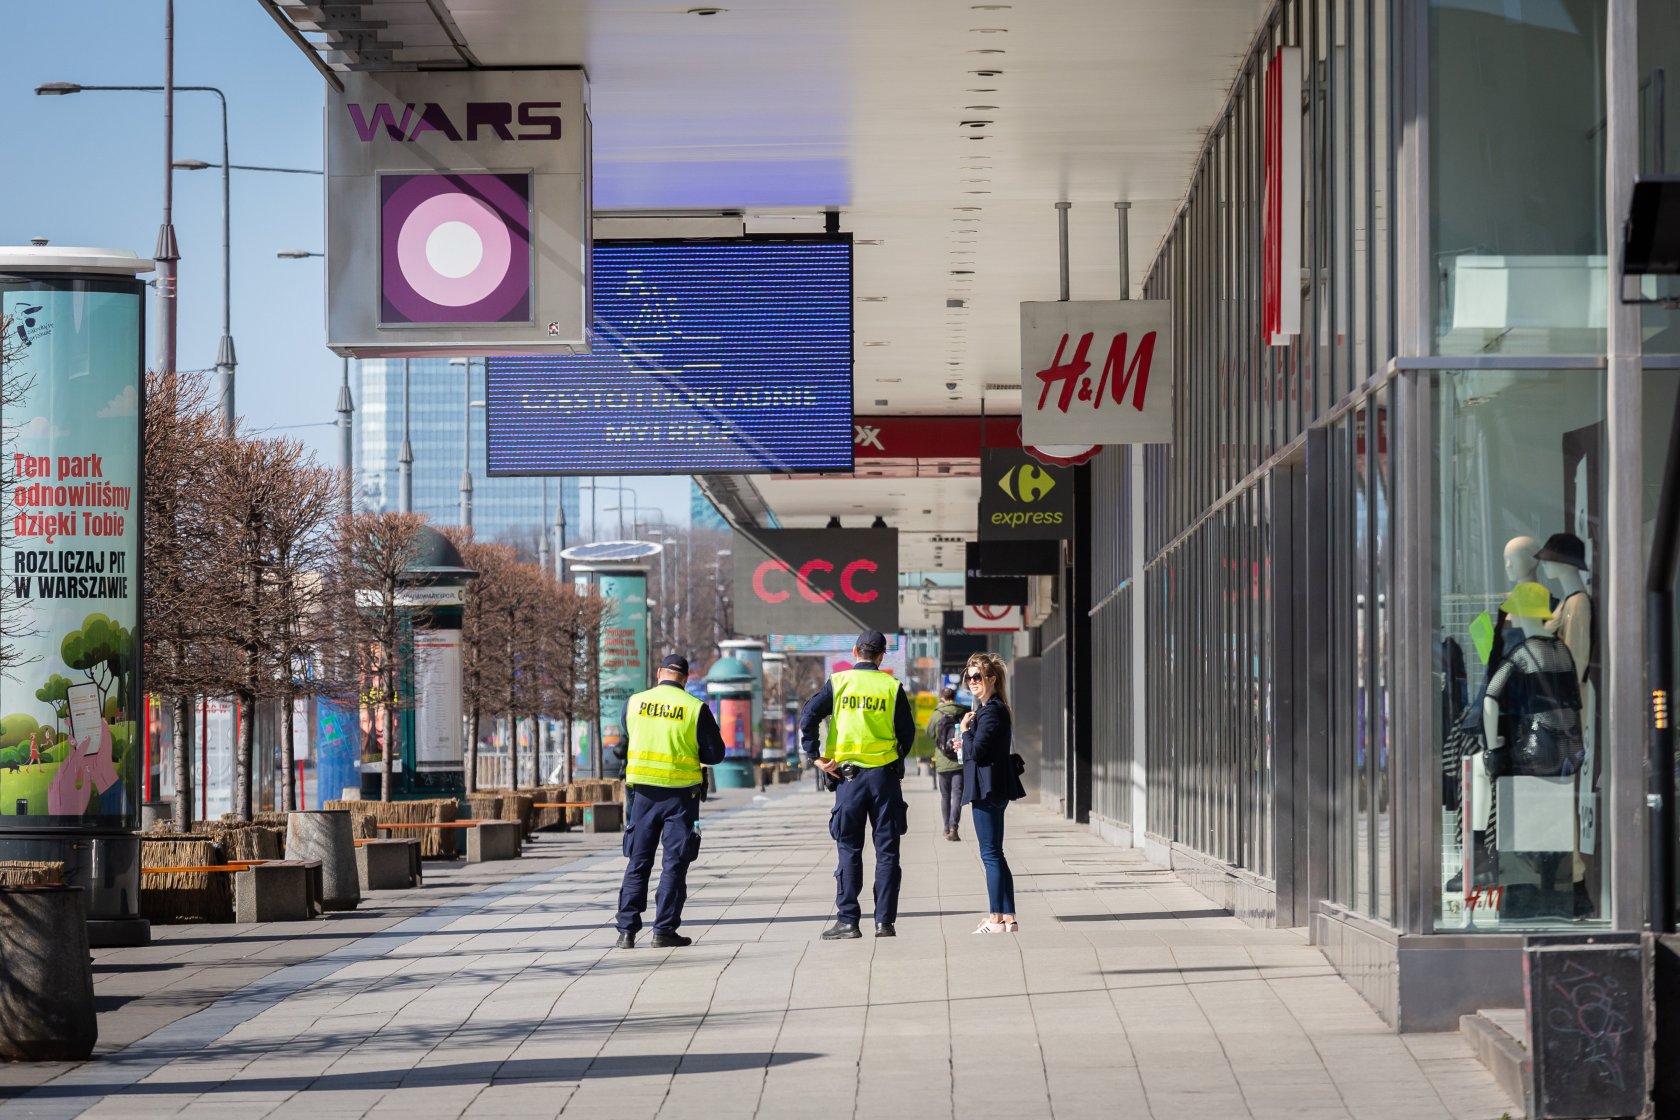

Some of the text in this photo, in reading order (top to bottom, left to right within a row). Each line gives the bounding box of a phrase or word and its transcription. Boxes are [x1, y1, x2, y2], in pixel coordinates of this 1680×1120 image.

[347, 102, 562, 142] WARS
[1036, 331, 1157, 413] H&M
[14, 453, 103, 481] Ten park
[14, 481, 131, 510] odnowiliśmy
[14, 511, 125, 544] dzięki Tobie
[991, 511, 1063, 528] express
[14, 551, 126, 574] ROZLICZAJ PIT
[14, 577, 128, 598] W WARSZAWIE
[752, 559, 879, 604] CCC
[639, 701, 684, 721] POLICJA
[842, 695, 886, 712] POLICJA
